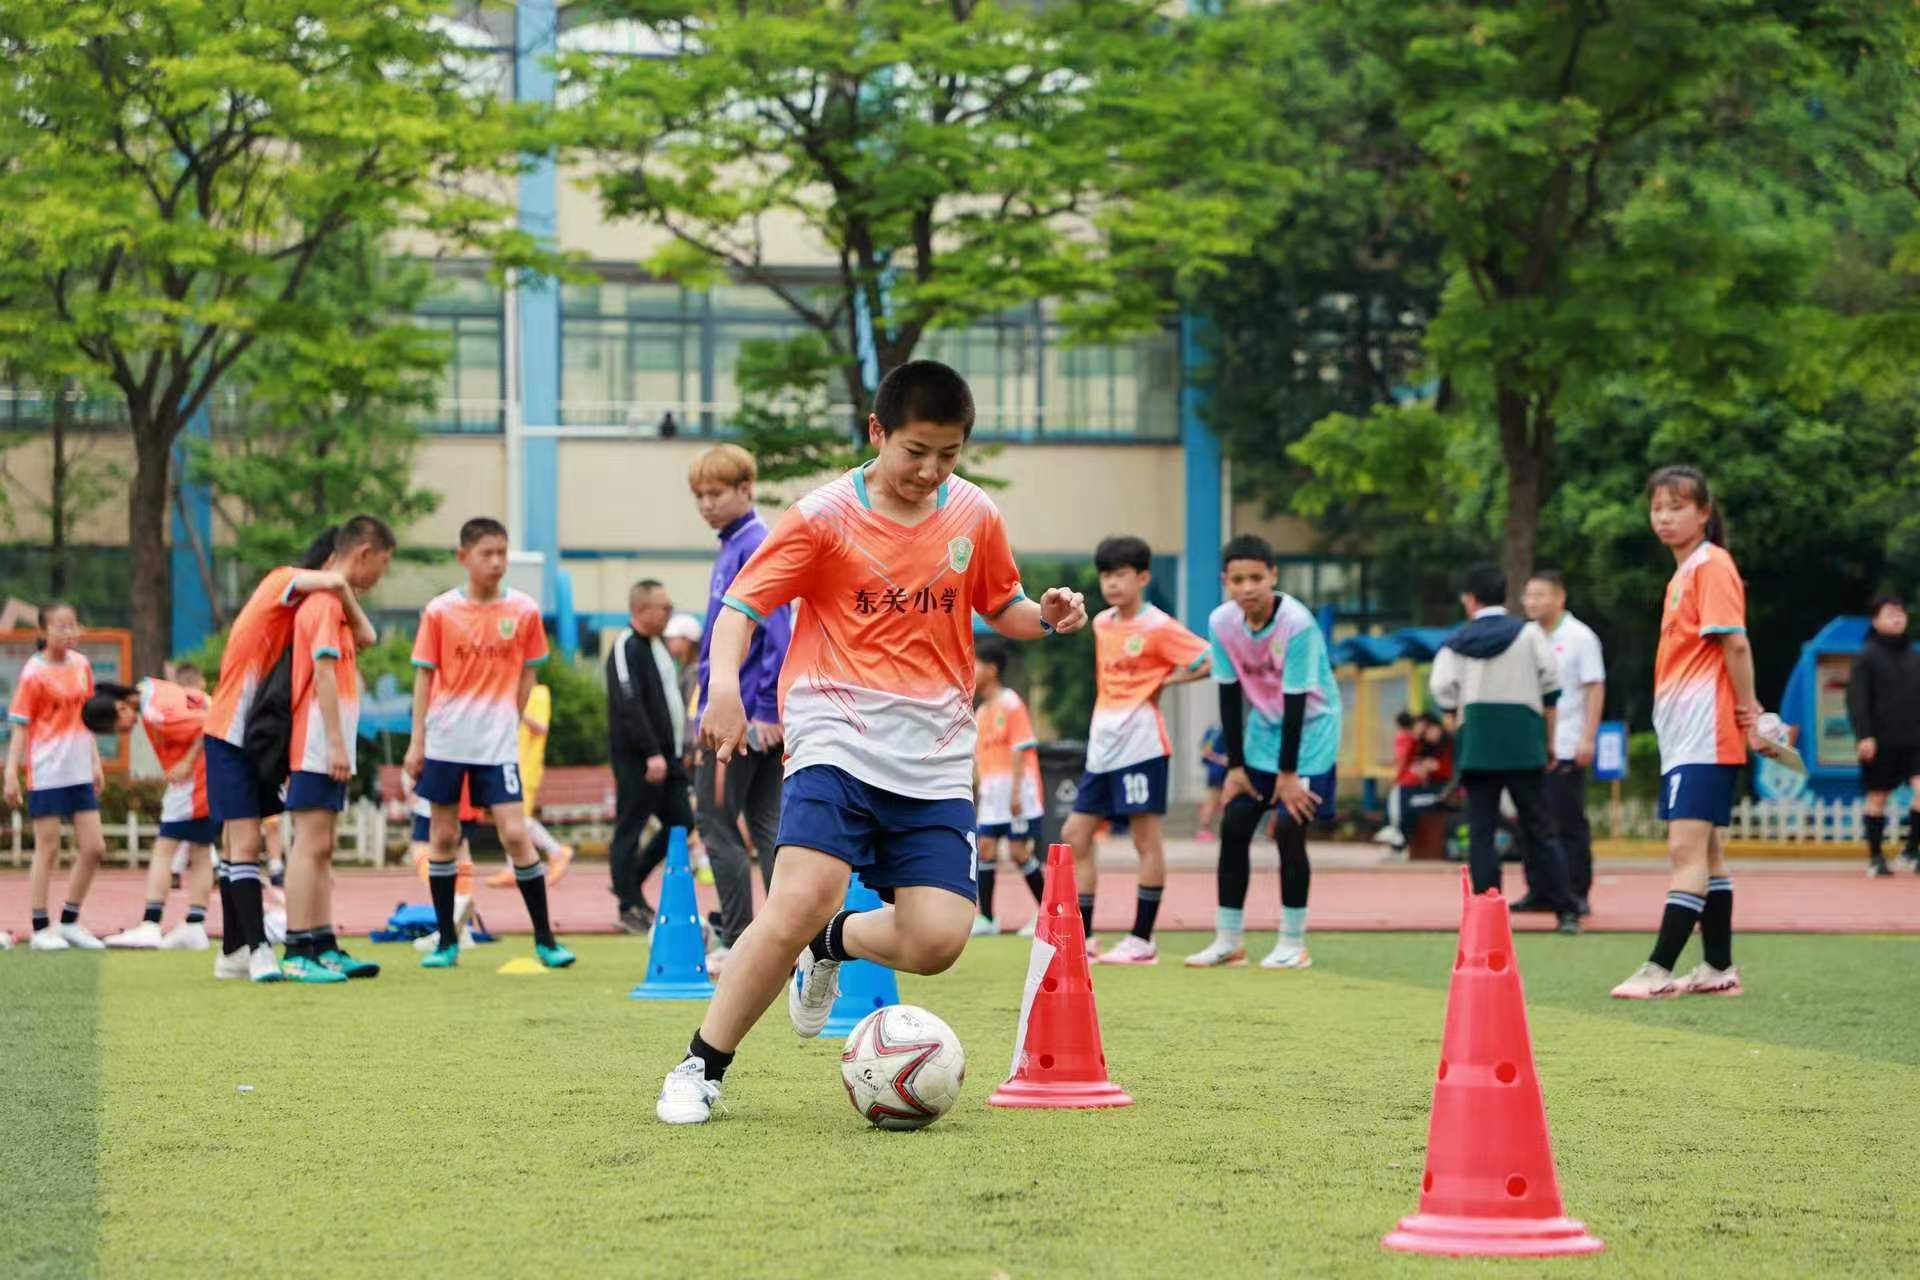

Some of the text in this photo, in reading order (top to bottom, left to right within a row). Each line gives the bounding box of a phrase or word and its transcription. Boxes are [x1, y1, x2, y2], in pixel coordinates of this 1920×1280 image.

[854, 588, 958, 614] 东关小学
[503, 764, 519, 794] 5
[1123, 773, 1149, 804] 10
